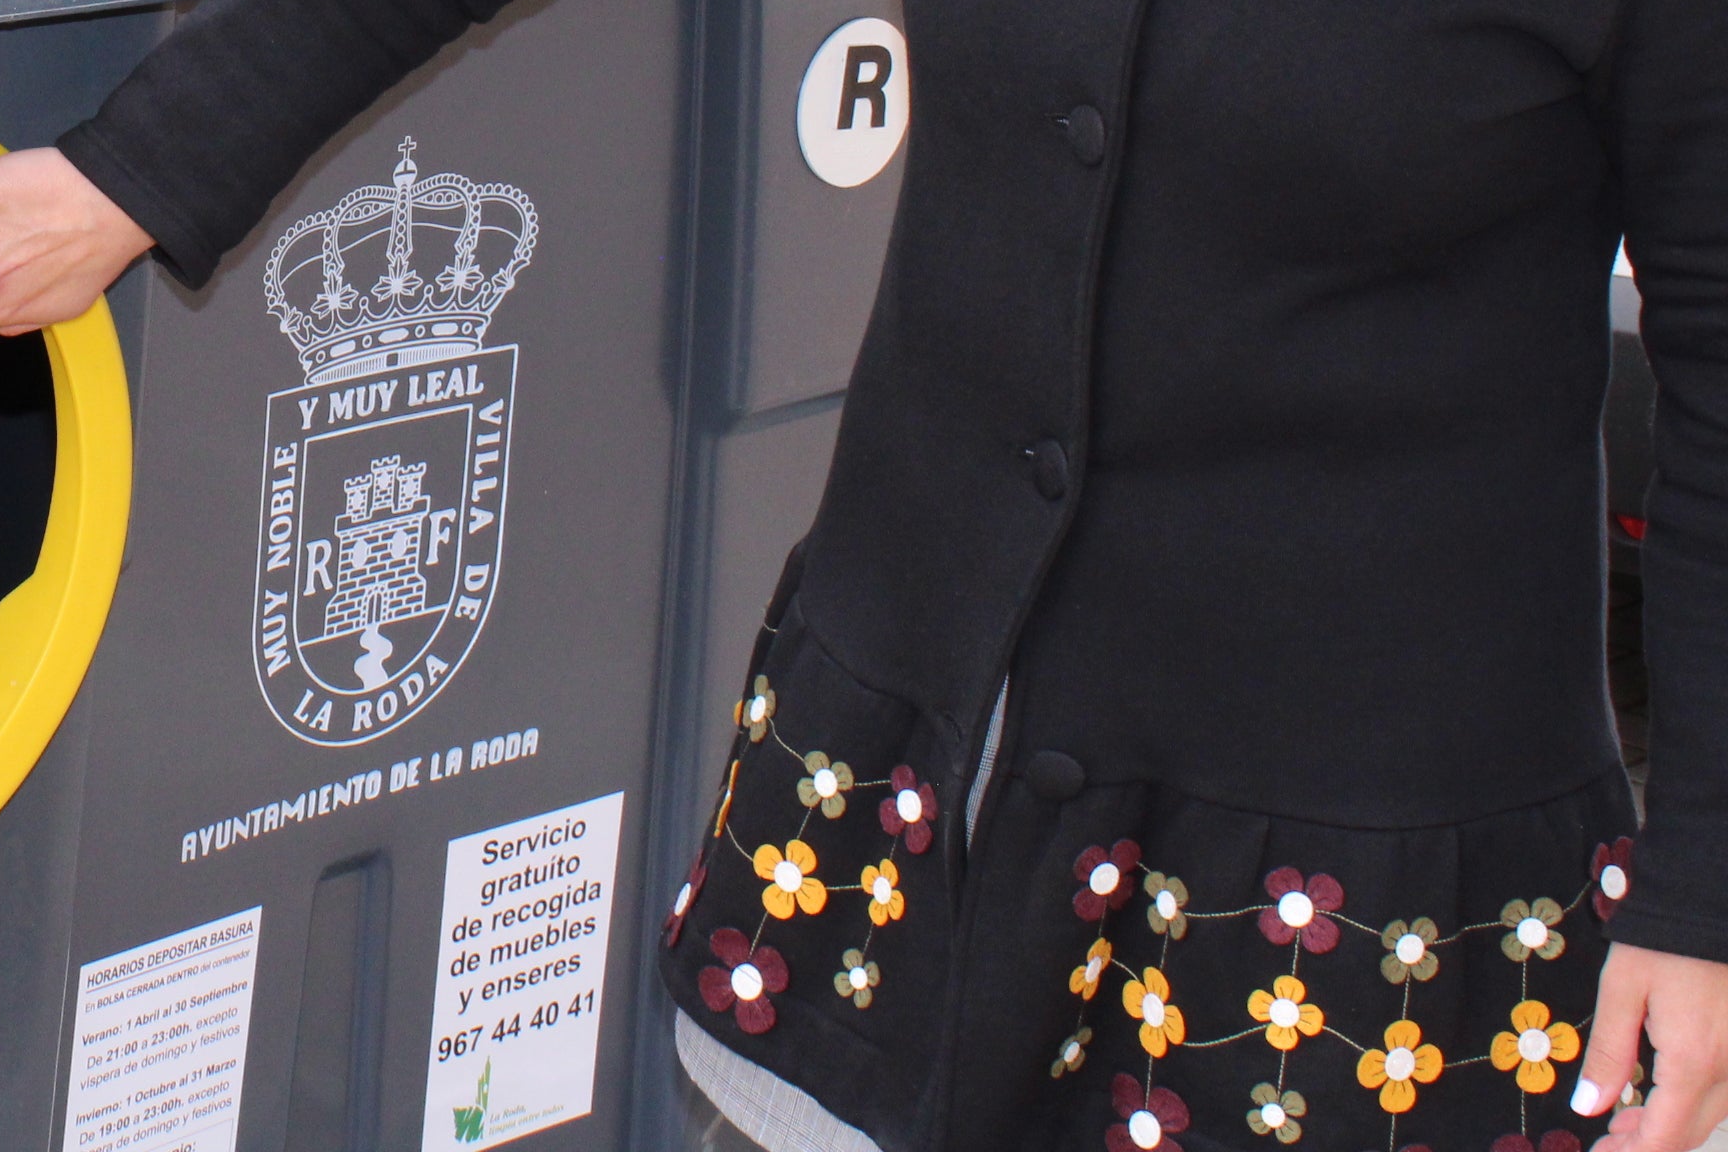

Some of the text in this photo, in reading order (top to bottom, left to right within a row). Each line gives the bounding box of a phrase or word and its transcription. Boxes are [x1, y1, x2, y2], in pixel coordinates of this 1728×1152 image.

[837, 45, 892, 130] R
[298, 364, 484, 430] Y MUY LEAL
[455, 398, 505, 620] VILLA DE
[262, 442, 298, 678] MUY NOBLE
[303, 508, 457, 597] R F
[293, 653, 449, 732] LA RODA
[181, 728, 539, 863] AYUNTAMIENTO DE LA RODA
[482, 818, 586, 866] Servicio
[452, 879, 601, 943] de recogida
[481, 854, 580, 906] gratuíto
[87, 920, 253, 988] HORARIOS DEPOSITAR BASURA
[450, 915, 596, 977] de muebles
[82, 980, 248, 1047] Verano: 1 Abril al 30 Septiembre
[97, 992, 124, 1009] BOLSA
[126, 977, 165, 998] CERRADA
[167, 965, 199, 984] DENTRO
[458, 953, 581, 1015] y enseres
[87, 1006, 238, 1069] De 21:00 a 23:00h. excepto
[124, 1061, 138, 1075] de
[141, 1043, 188, 1068] domingo
[190, 1040, 197, 1054] y
[200, 1024, 240, 1047] festivos
[438, 989, 595, 1062] 967 44 40 41
[76, 1101, 122, 1127] Invierno:
[135, 1081, 176, 1103] Octubre
[179, 1073, 189, 1087] al
[191, 1068, 202, 1082] 31
[206, 1058, 236, 1077] Marzo
[80, 1131, 95, 1146] De
[100, 1116, 130, 1137] 19:00
[133, 1115, 140, 1125] a
[188, 1080, 230, 1104] excepto
[116, 1136, 130, 1149] de
[133, 1117, 180, 1142] domingo
[192, 1097, 232, 1120] festivos
